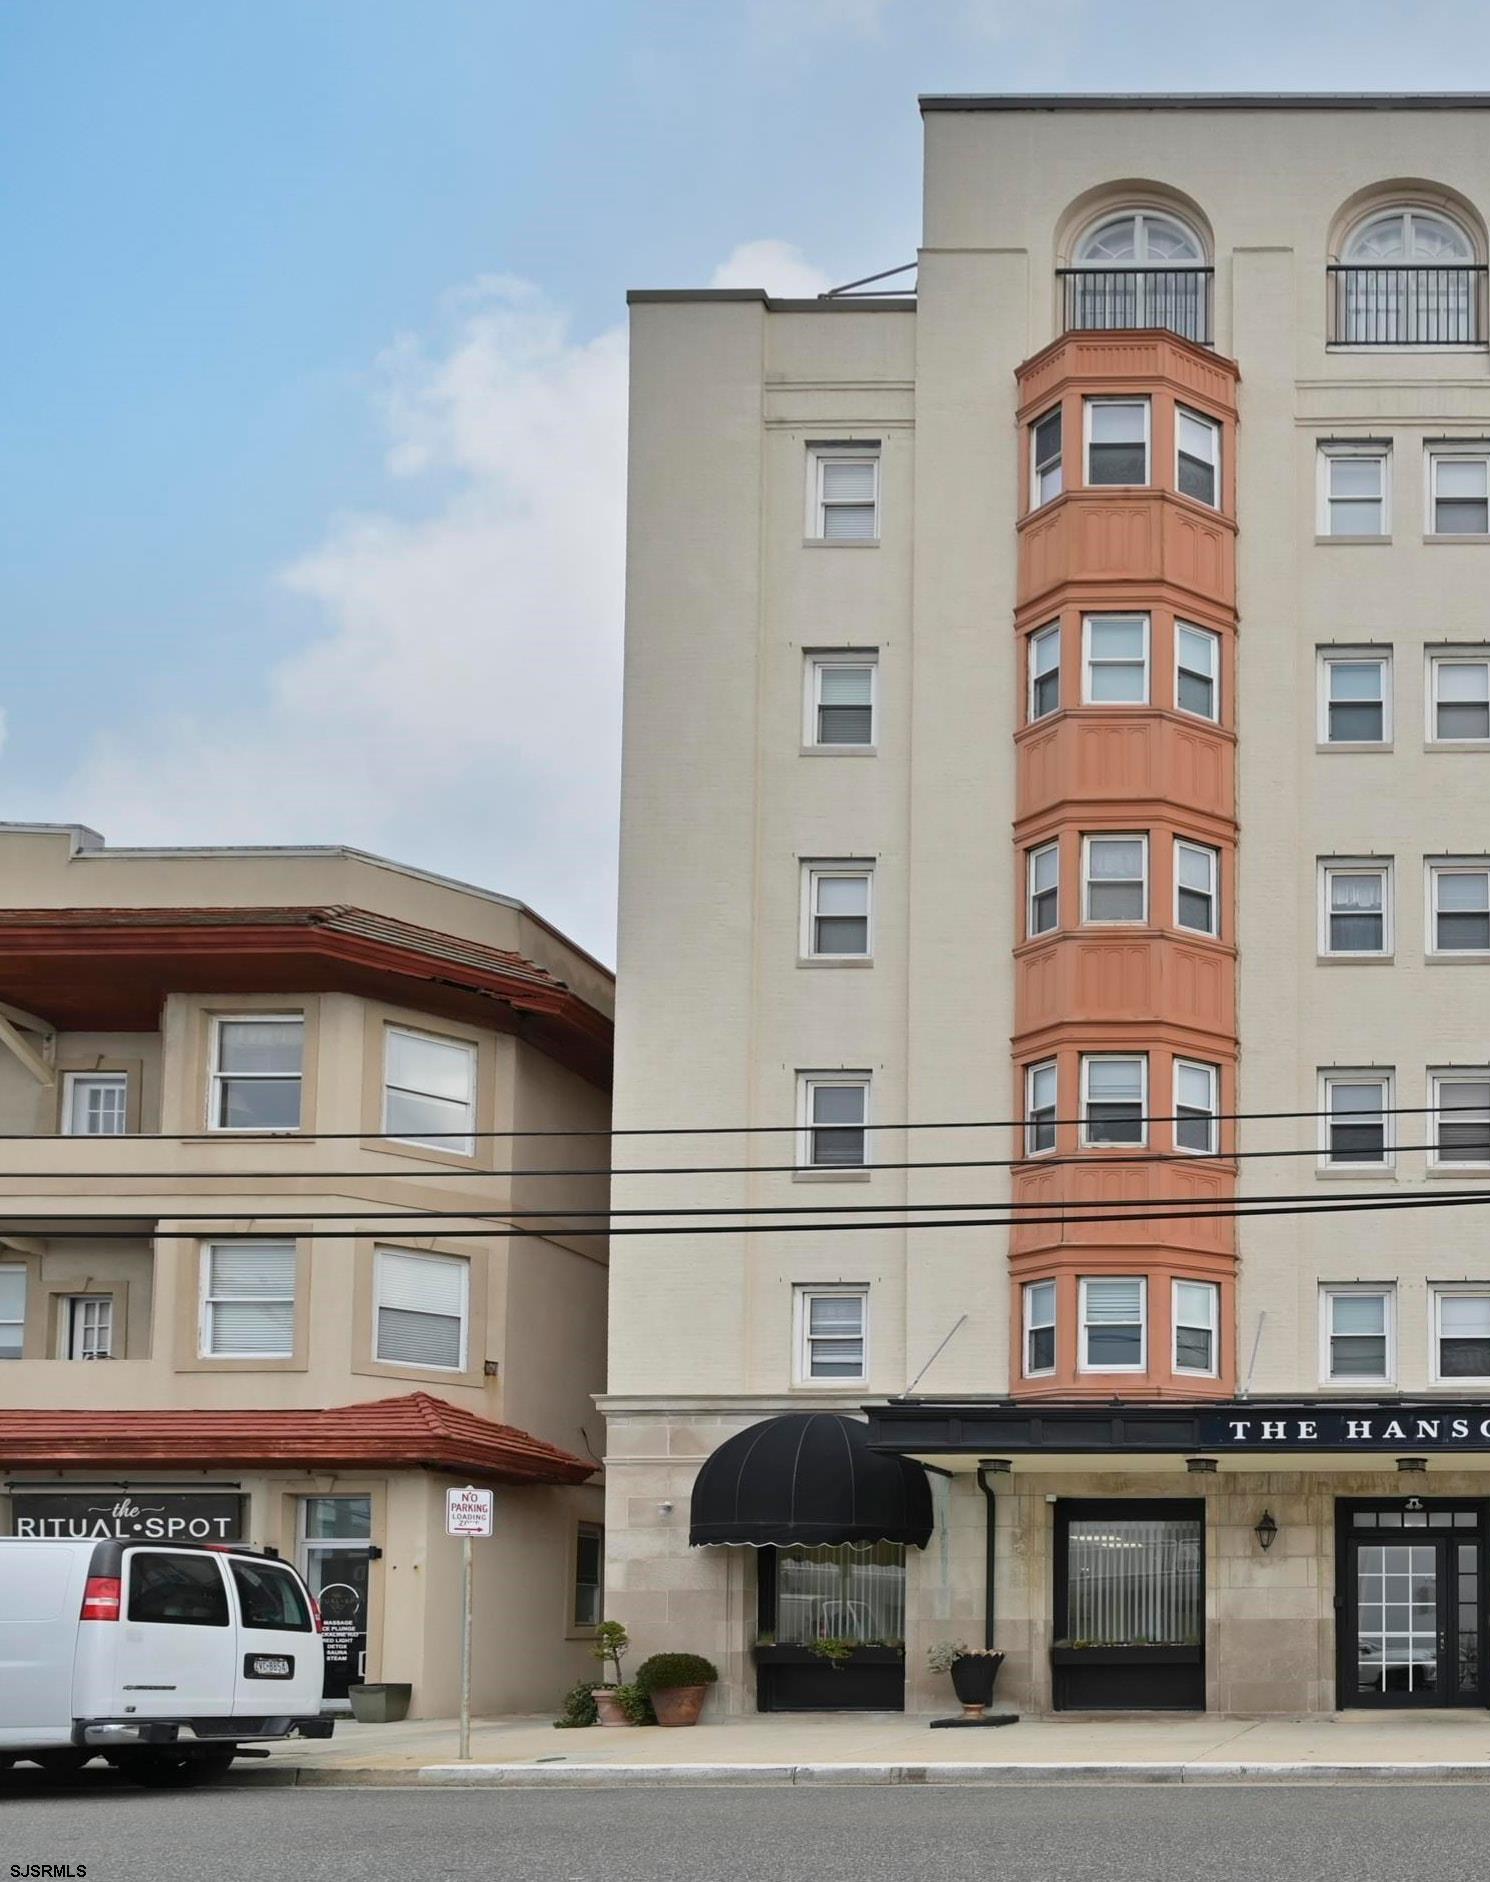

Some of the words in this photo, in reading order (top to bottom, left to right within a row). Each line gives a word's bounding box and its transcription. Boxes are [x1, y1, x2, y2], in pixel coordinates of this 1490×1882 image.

[1229, 1420, 1319, 1440] THE
[461, 1493, 478, 1503] NO
[111, 1498, 142, 1518] the
[451, 1502, 488, 1513] PARKING
[452, 1513, 487, 1521] LOADING
